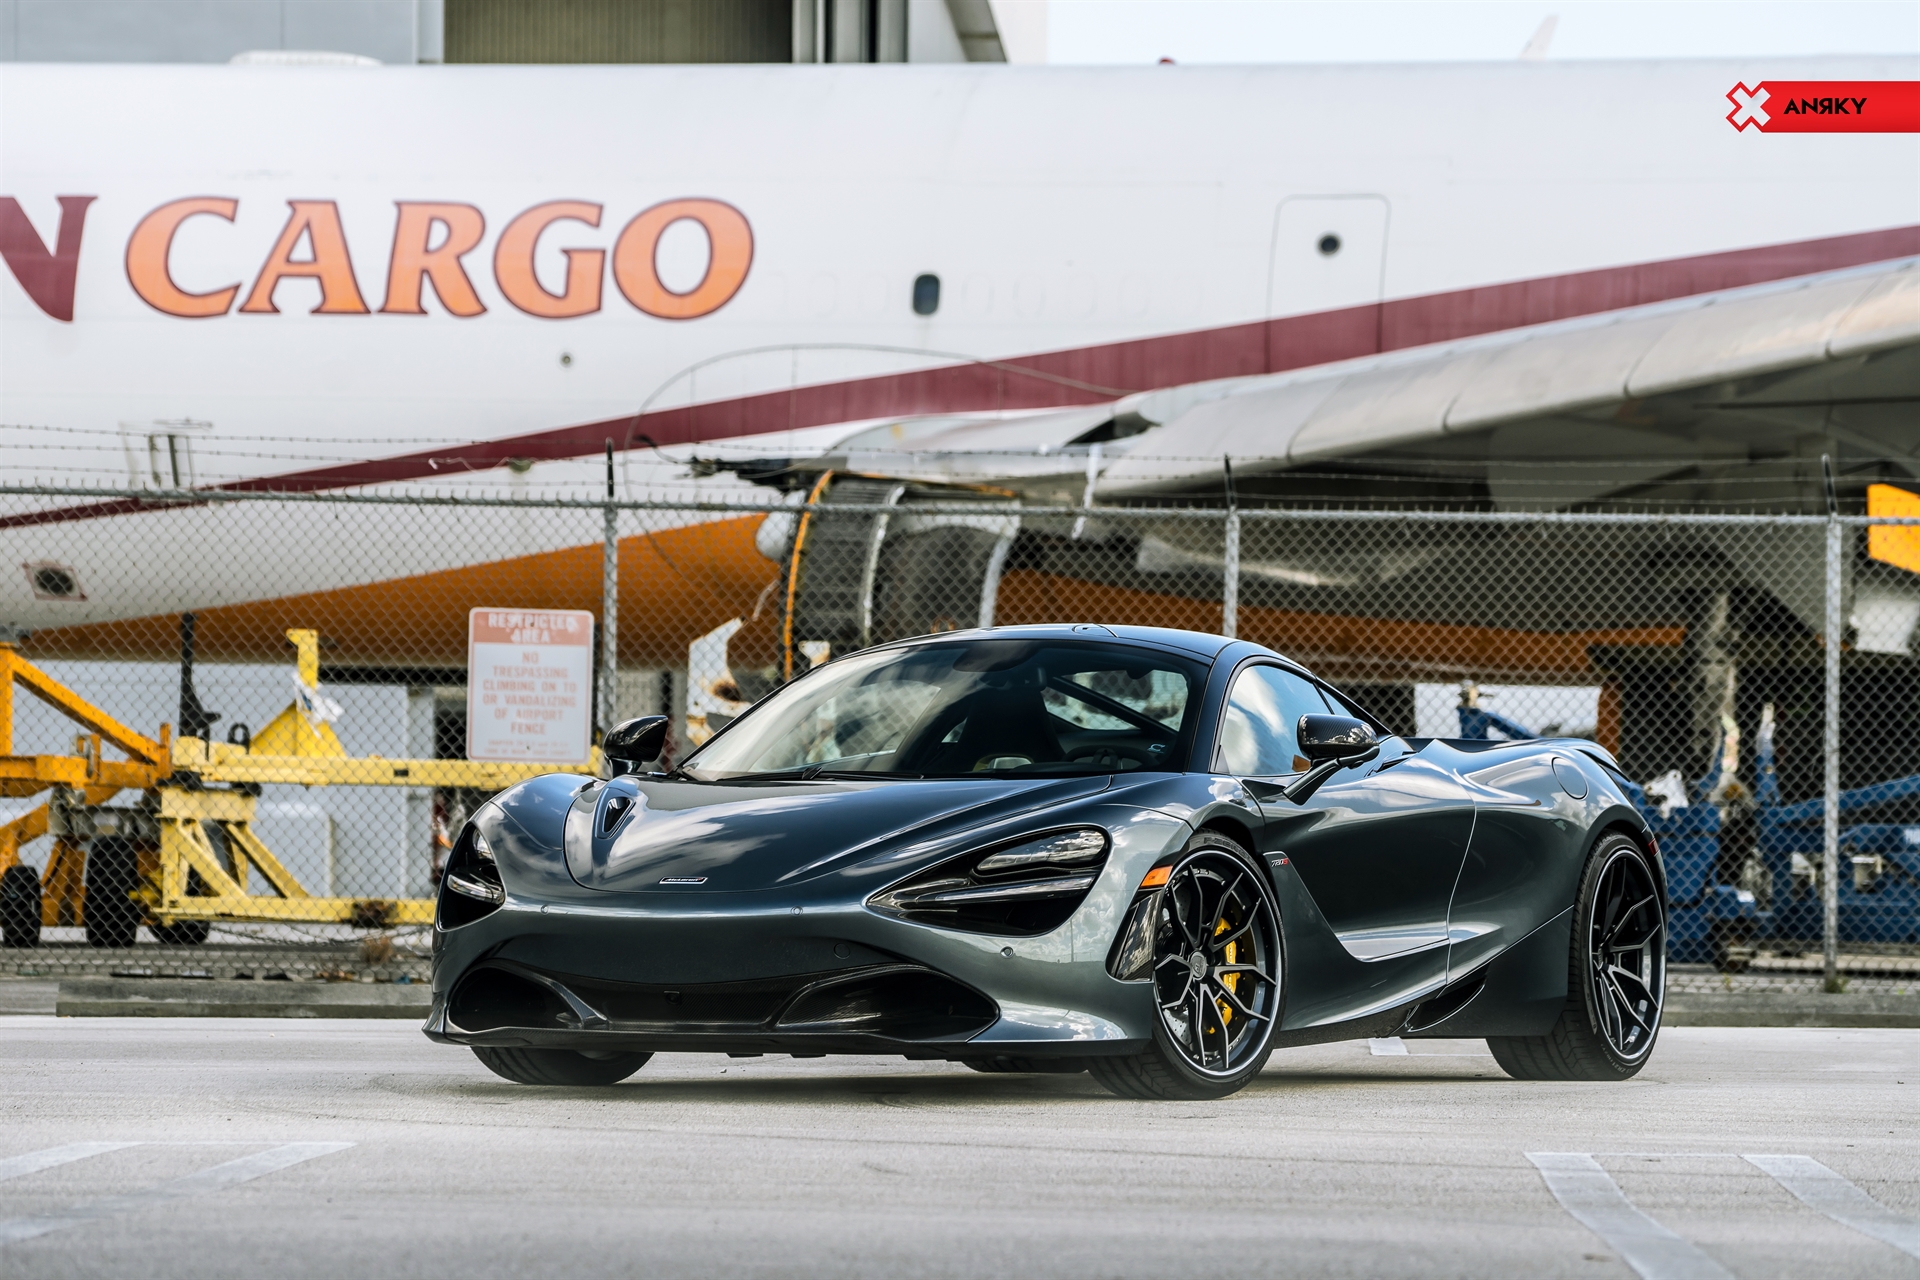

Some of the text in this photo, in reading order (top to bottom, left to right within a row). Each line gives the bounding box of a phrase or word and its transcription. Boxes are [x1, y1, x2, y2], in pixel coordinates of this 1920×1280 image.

[125, 195, 755, 321] CARGO
[511, 629, 550, 643] AREA
[522, 652, 540, 664] NO
[493, 665, 569, 678] TRESPASSING
[483, 680, 577, 693] CLIMBING ON TO
[483, 694, 577, 707] OR VANDALIZING
[494, 708, 564, 720] OF AIRPORT
[511, 723, 546, 735] FENCE
